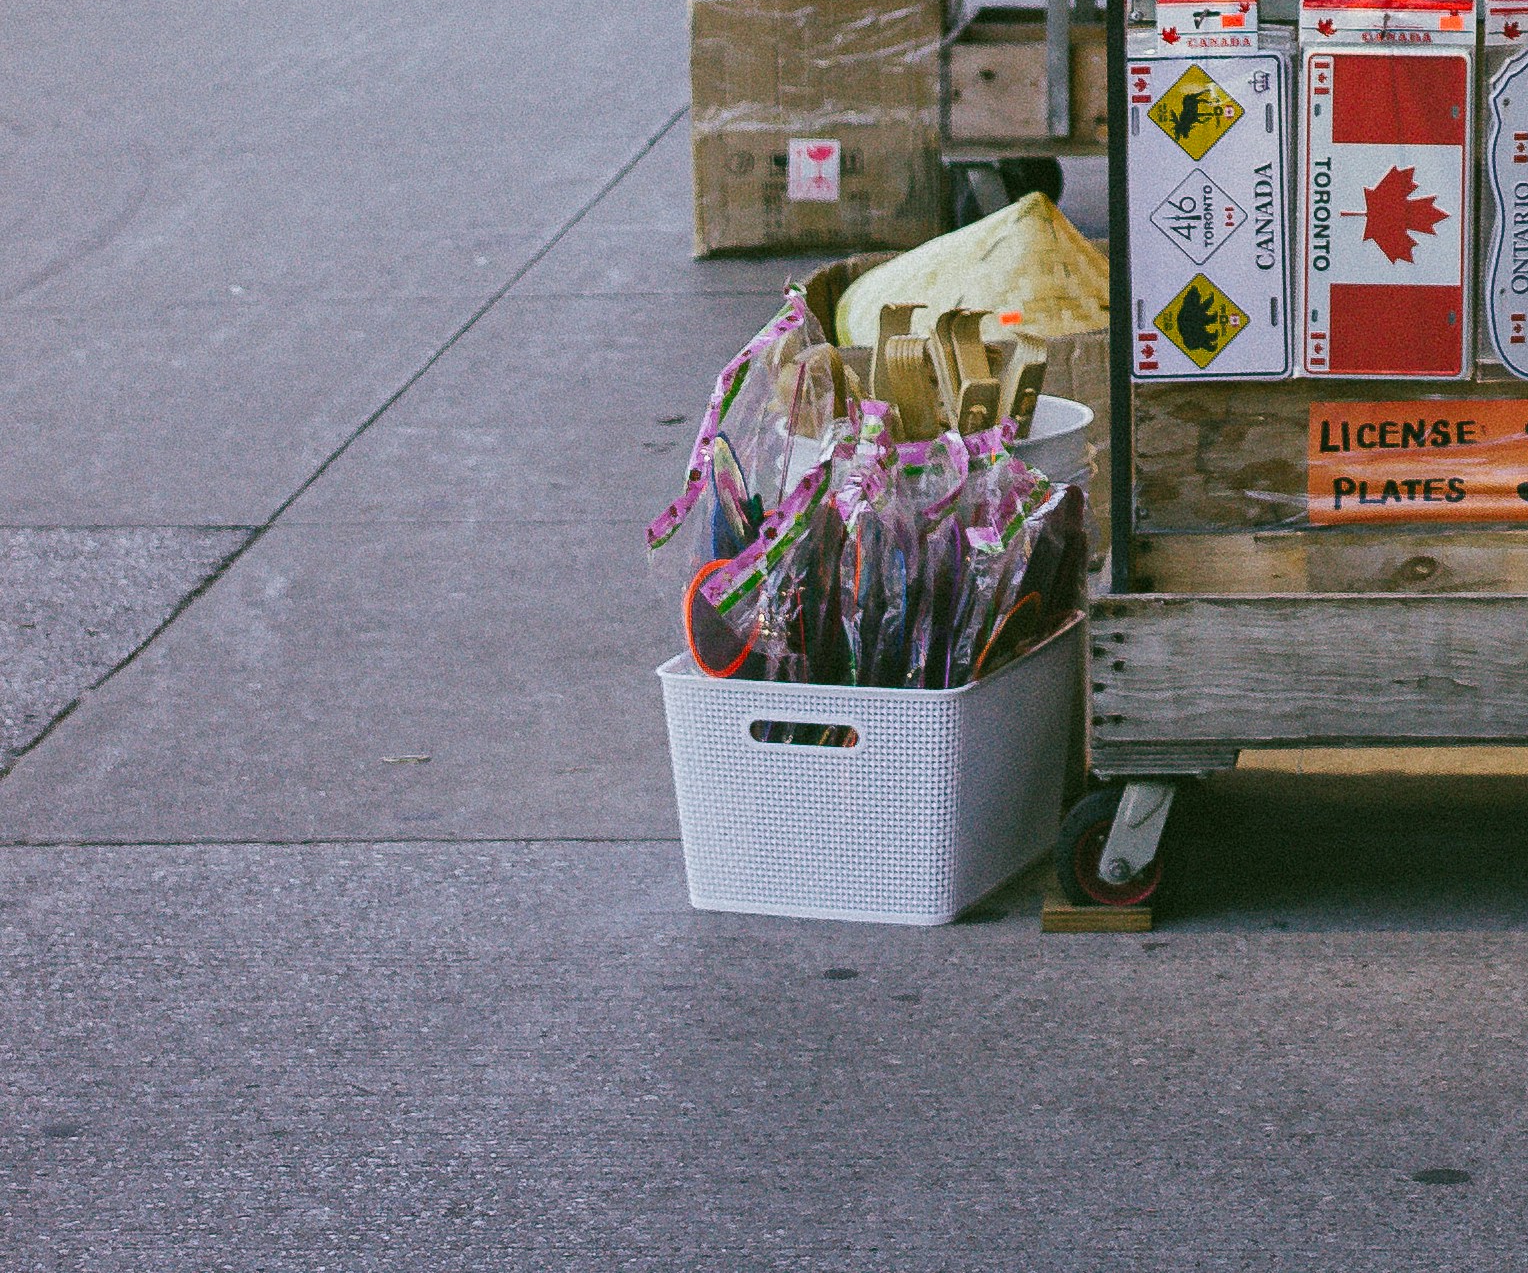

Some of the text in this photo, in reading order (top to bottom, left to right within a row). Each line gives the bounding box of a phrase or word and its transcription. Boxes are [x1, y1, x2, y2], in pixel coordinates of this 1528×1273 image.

[1186, 37, 1252, 48] CANADA
[1361, 31, 1432, 43] CANADA
[1204, 184, 1214, 248] TORONTO
[1254, 161, 1275, 270] CANADA
[1312, 156, 1332, 272] TORONTO
[1319, 419, 1476, 454] LICENSE
[1333, 477, 1466, 510] PLATES
